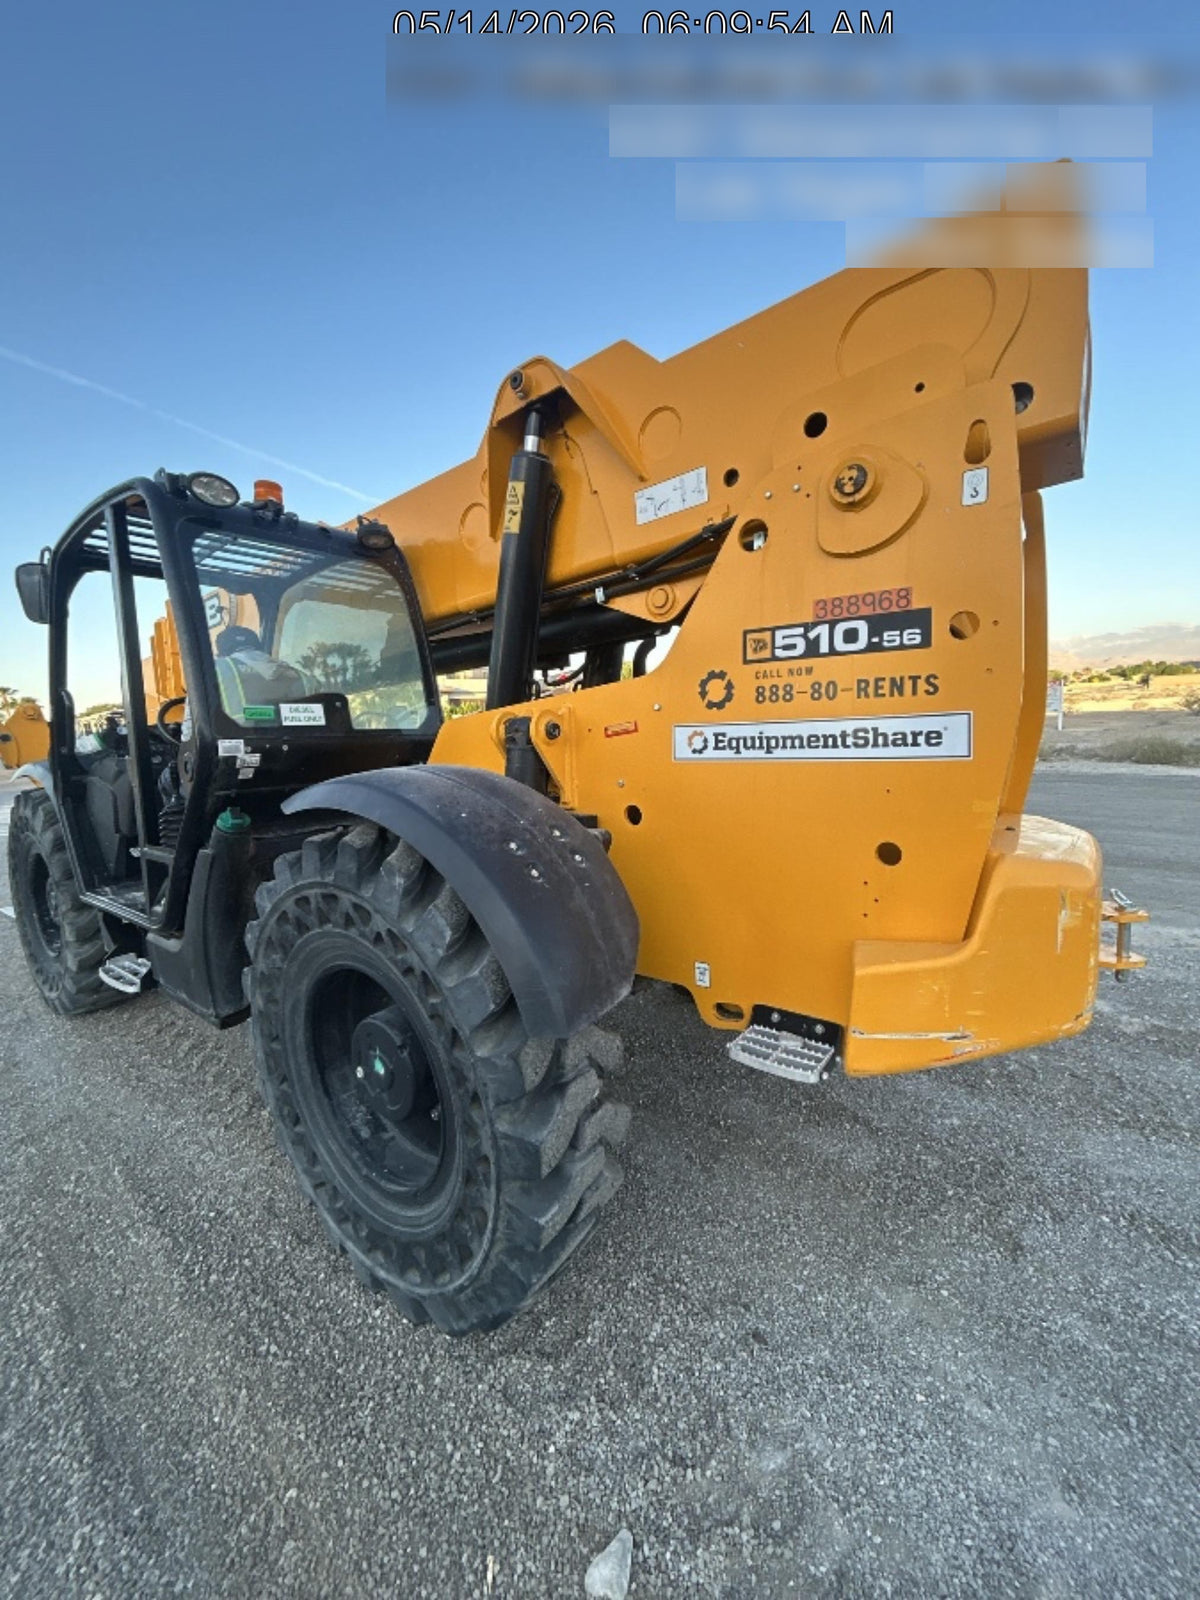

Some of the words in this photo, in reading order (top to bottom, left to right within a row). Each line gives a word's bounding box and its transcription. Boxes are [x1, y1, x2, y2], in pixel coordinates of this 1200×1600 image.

[815, 588, 911, 619] 388968
[774, 620, 922, 658] 510-56
[755, 669, 783, 680] CALL
[787, 666, 814, 678] NOW
[755, 673, 940, 704] 888-80-RENTS
[712, 726, 944, 756] EquipmentShare
